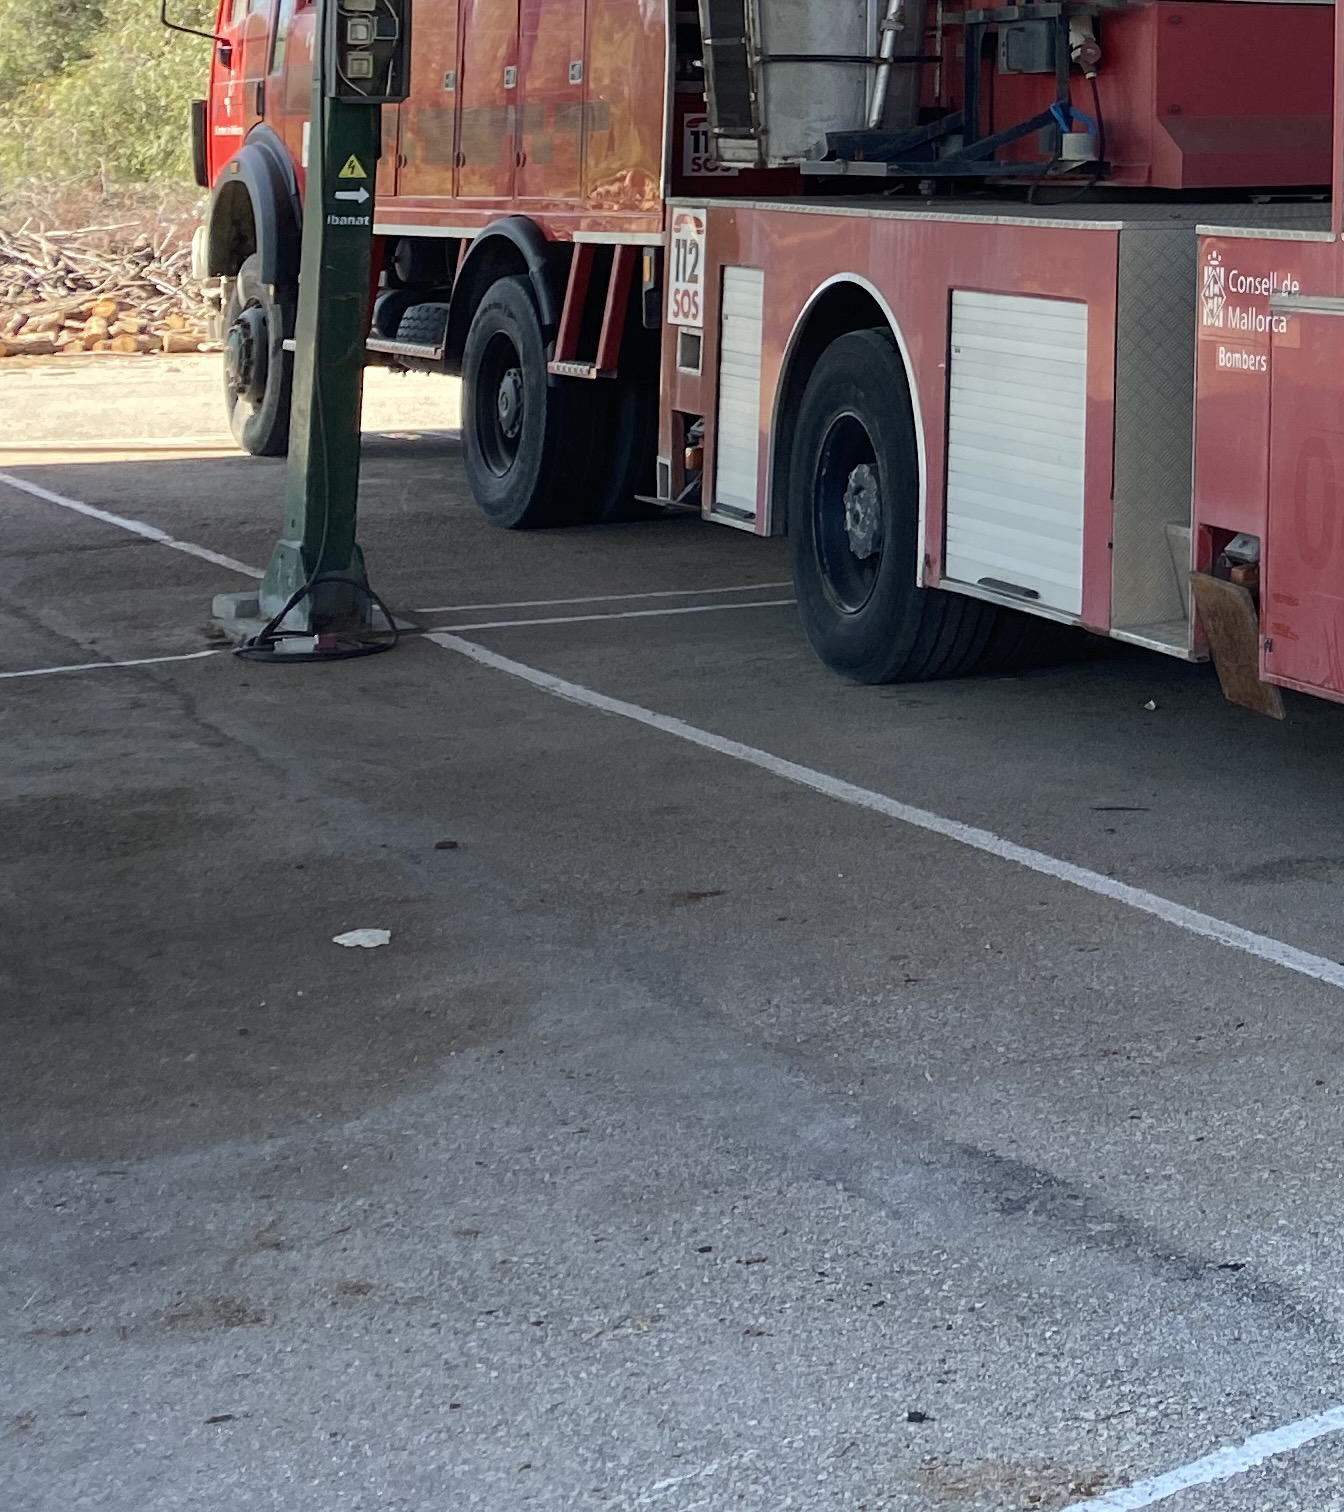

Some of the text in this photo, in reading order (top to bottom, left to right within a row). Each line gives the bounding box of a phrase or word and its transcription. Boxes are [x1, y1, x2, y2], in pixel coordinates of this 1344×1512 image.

[690, 130, 709, 154] 11
[674, 238, 700, 284] 112
[1228, 270, 1300, 296] Consell de
[673, 287, 699, 321] SOS
[1227, 305, 1288, 333] Mallorca
[1218, 346, 1268, 372] Bombers
